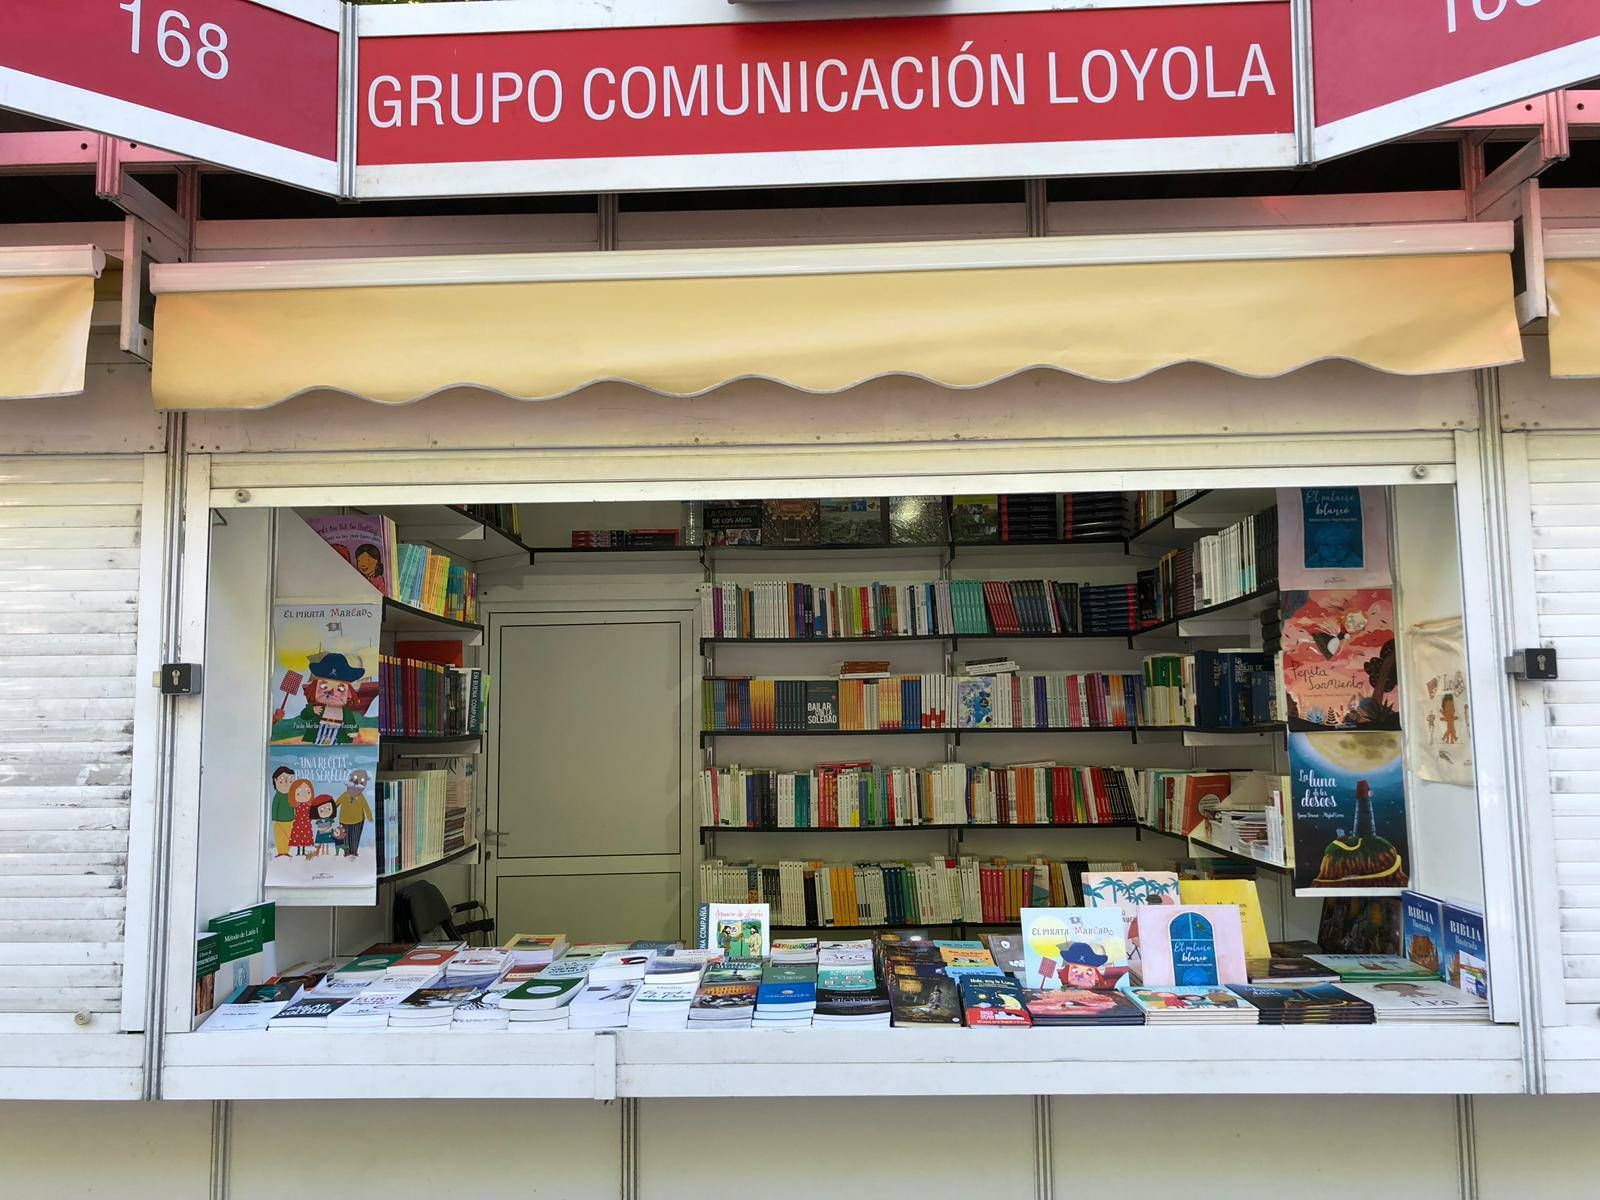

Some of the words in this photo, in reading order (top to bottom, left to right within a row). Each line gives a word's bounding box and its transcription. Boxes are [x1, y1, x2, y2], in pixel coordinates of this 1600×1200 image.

[118, 0, 230, 81] 168
[367, 69, 563, 129] GRUPO
[582, 40, 1026, 121] COMUNICACIÓN
[1048, 43, 1277, 104] LOYOLA
[283, 609, 294, 618] EL
[296, 608, 325, 618] PIRATA
[330, 608, 373, 618] MAREADO
[1289, 660, 1328, 683] Pepita
[1308, 672, 1363, 690] Sarmiento
[807, 702, 832, 711] BAILAR
[807, 715, 838, 724] SOLEDAD
[301, 756, 317, 768] UNA
[319, 756, 347, 770] RECETA
[1298, 769, 1309, 782] La
[1309, 769, 1337, 787] luna
[1301, 789, 1338, 807] deseos
[699, 906, 708, 939] COMPAÑÍA
[1408, 905, 1434, 925] BIBLIA
[1031, 928, 1041, 936] EL
[1042, 928, 1070, 936] PIRATA
[1074, 926, 1114, 936] MAREADO
[1449, 920, 1481, 942] BIBLIA
[1174, 942, 1184, 952] El
[1185, 942, 1212, 953] palacio
[1181, 951, 1208, 962] blanco
